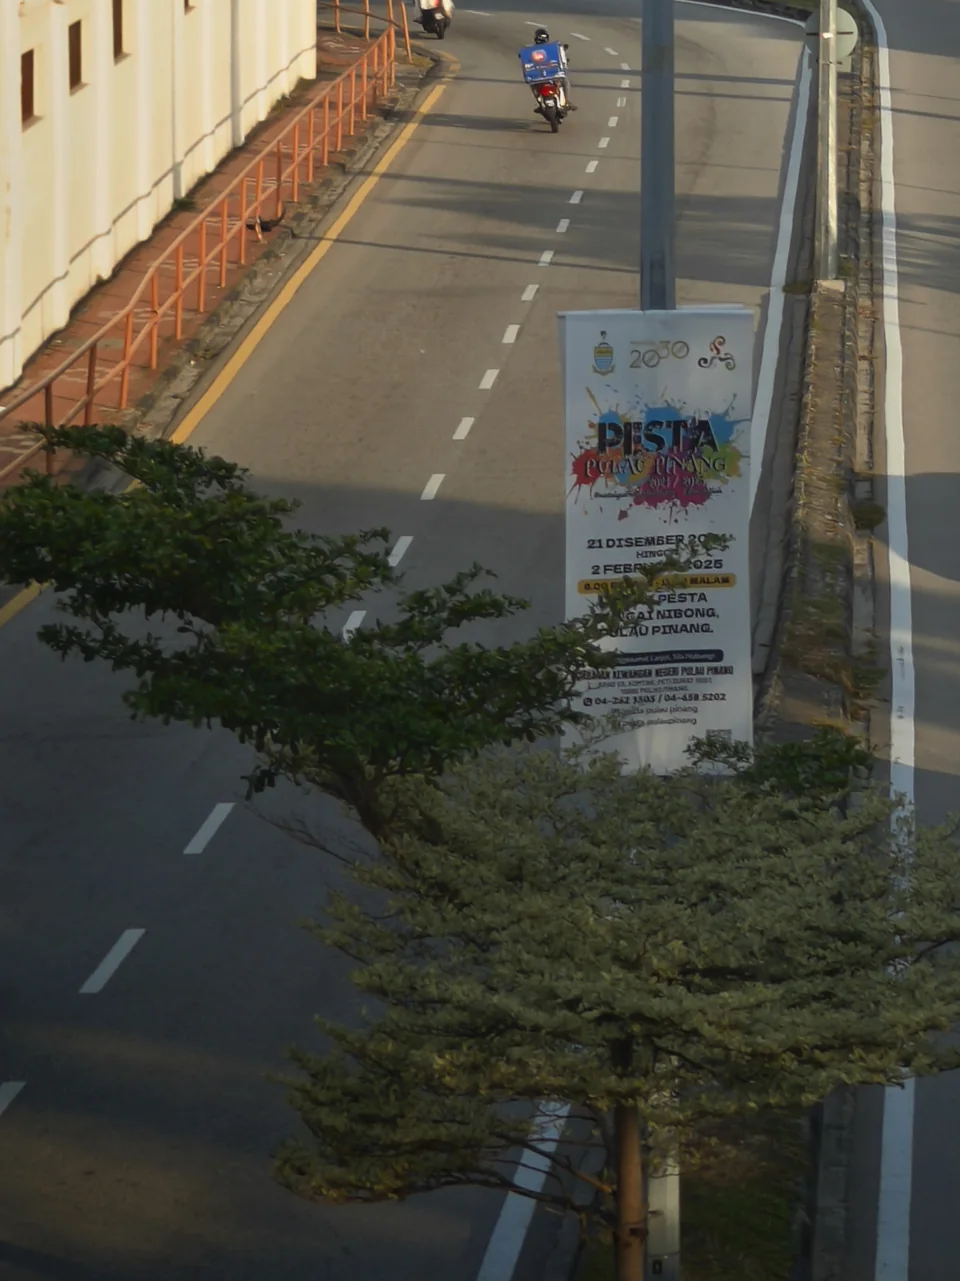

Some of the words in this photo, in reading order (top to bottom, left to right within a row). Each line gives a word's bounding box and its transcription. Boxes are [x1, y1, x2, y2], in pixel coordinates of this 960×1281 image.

[598, 418, 719, 455] PESTA
[653, 454, 726, 476] PINANG
[586, 539, 603, 550] 21
[605, 534, 685, 548] DISEMBER
[591, 564, 600, 575] 2
[658, 592, 708, 605] PESTA
[656, 607, 719, 621] NIBONG,
